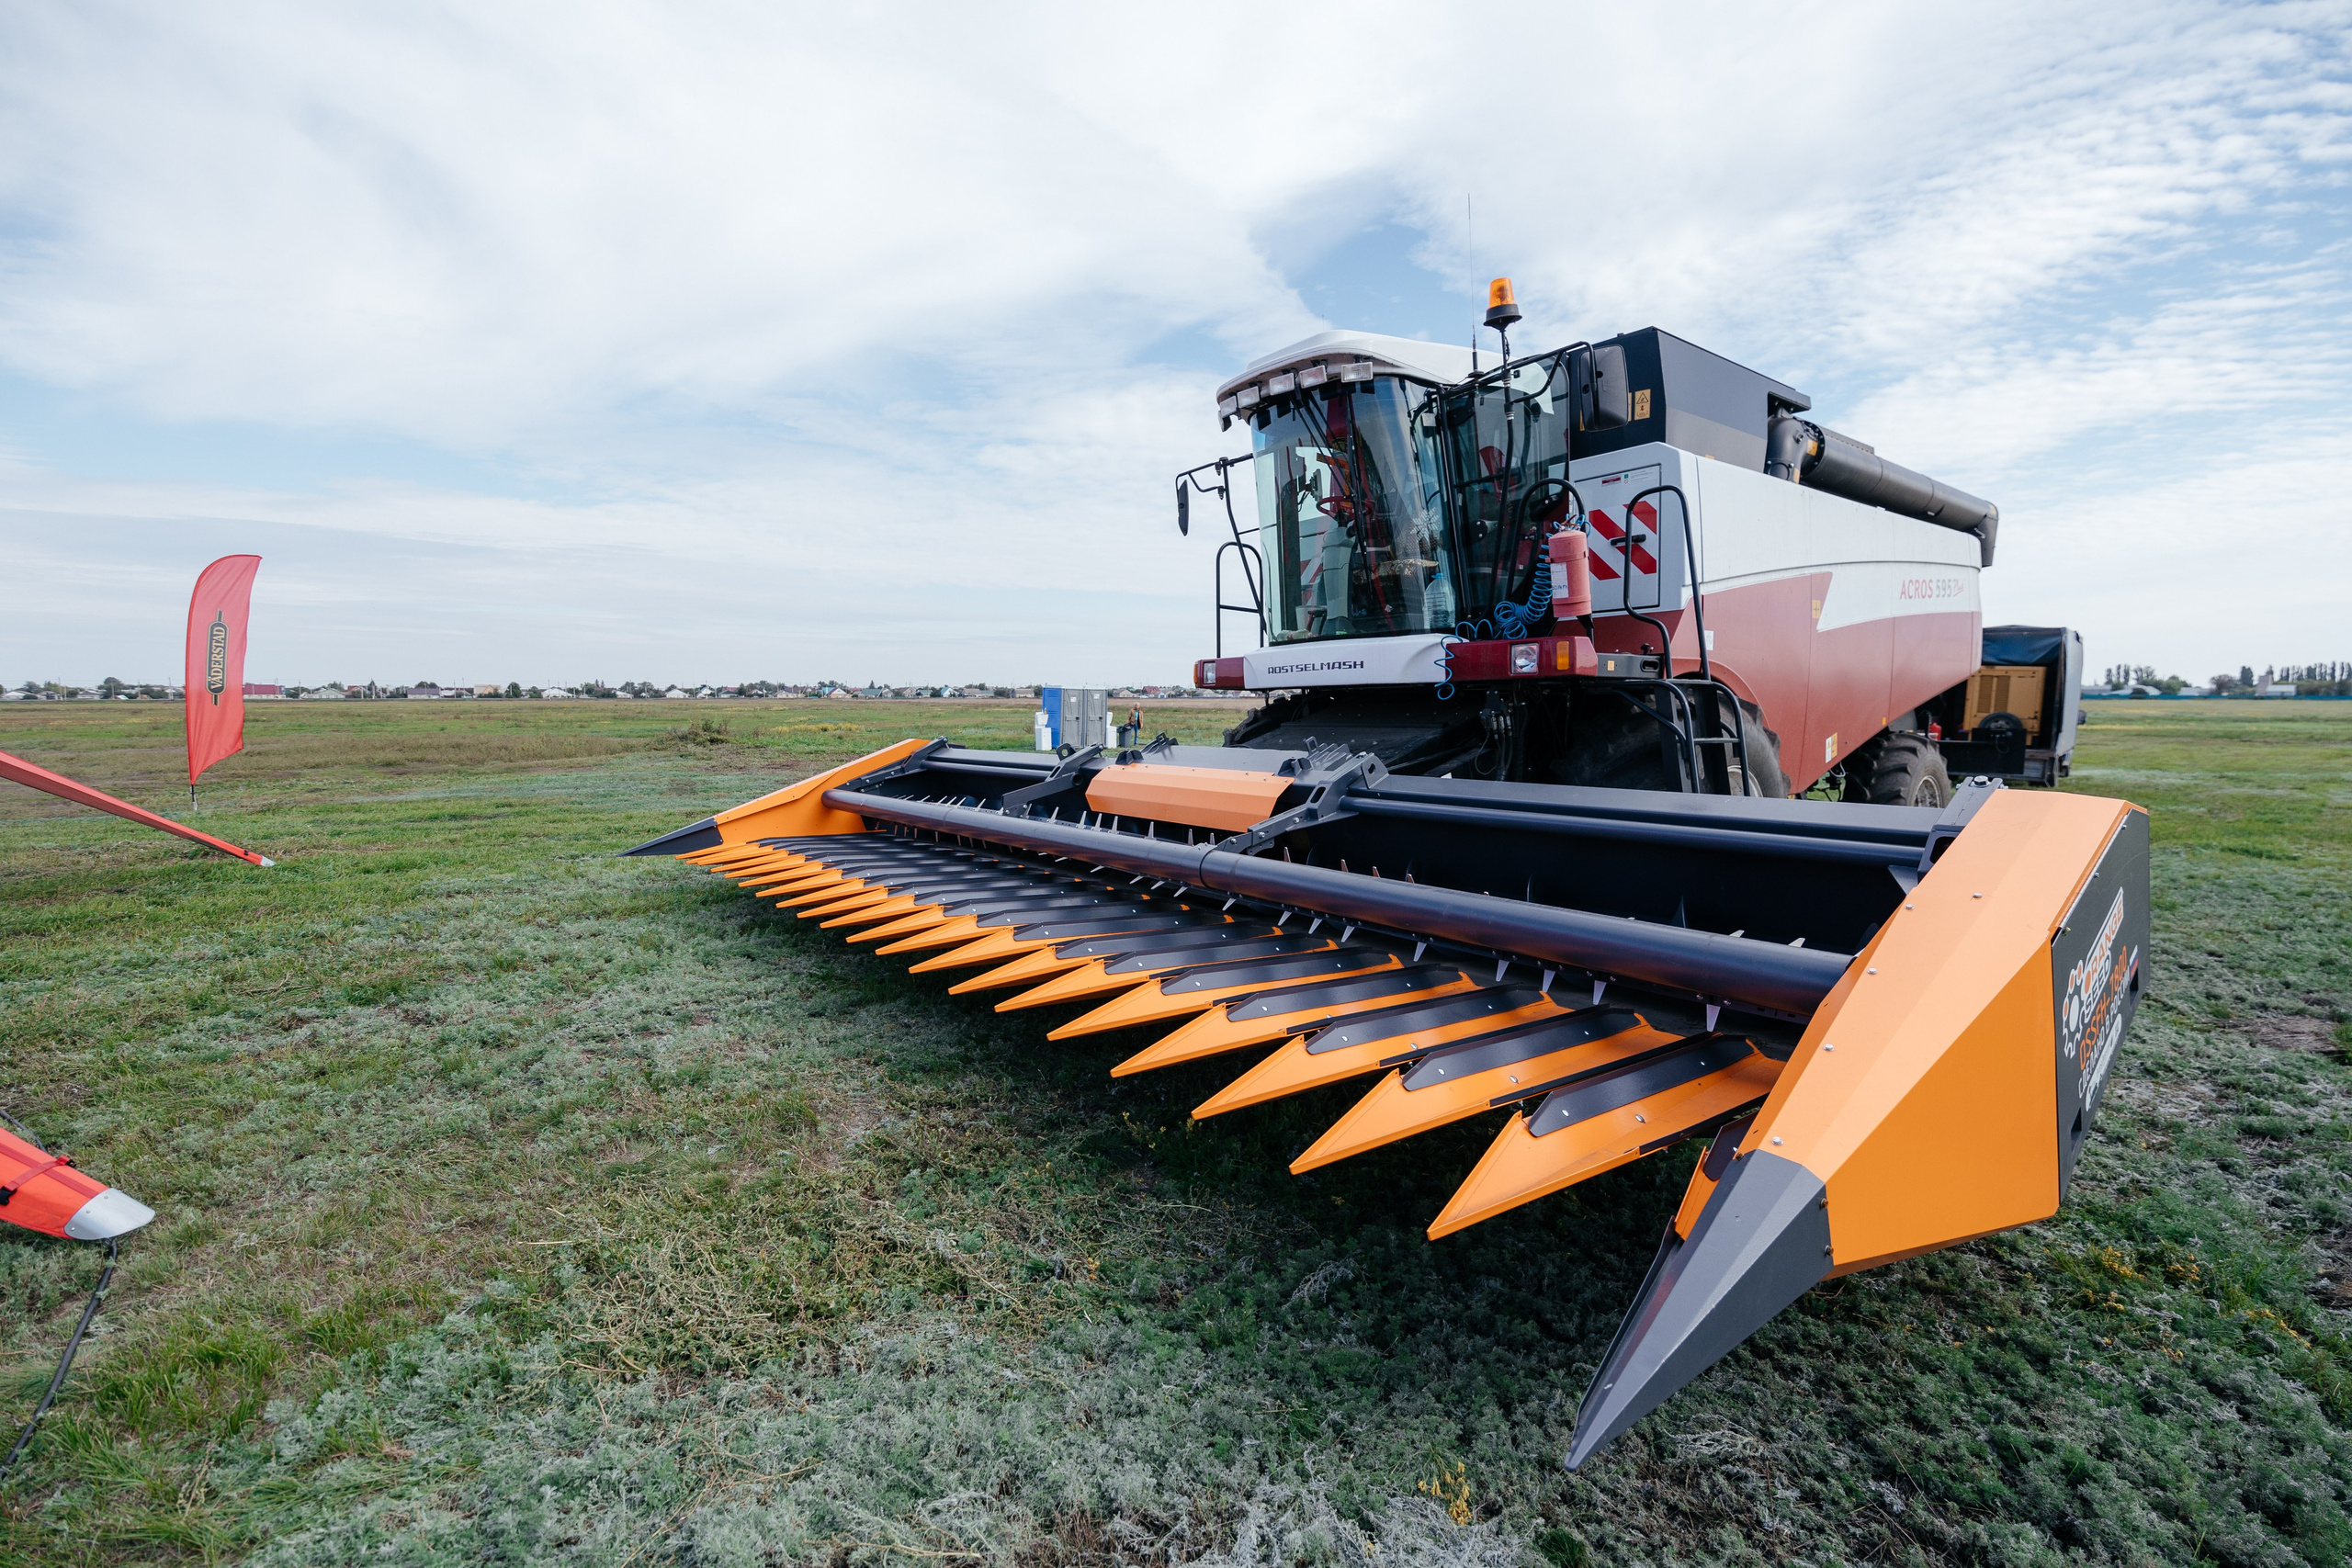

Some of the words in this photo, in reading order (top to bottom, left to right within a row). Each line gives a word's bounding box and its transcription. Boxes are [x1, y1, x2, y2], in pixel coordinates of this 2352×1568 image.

[1900, 579, 1933, 600] ACROS
[1936, 579, 1951, 598] 595
[208, 626, 226, 690] VÄDERSTAD
[1268, 660, 1364, 674] ROSTSELMASH
[2085, 900, 2123, 995] ORANGE
[2085, 954, 2110, 1015] SEED
[2078, 1025, 2106, 1099] СДЕЛАНО
[2105, 1014, 2110, 1035] В
